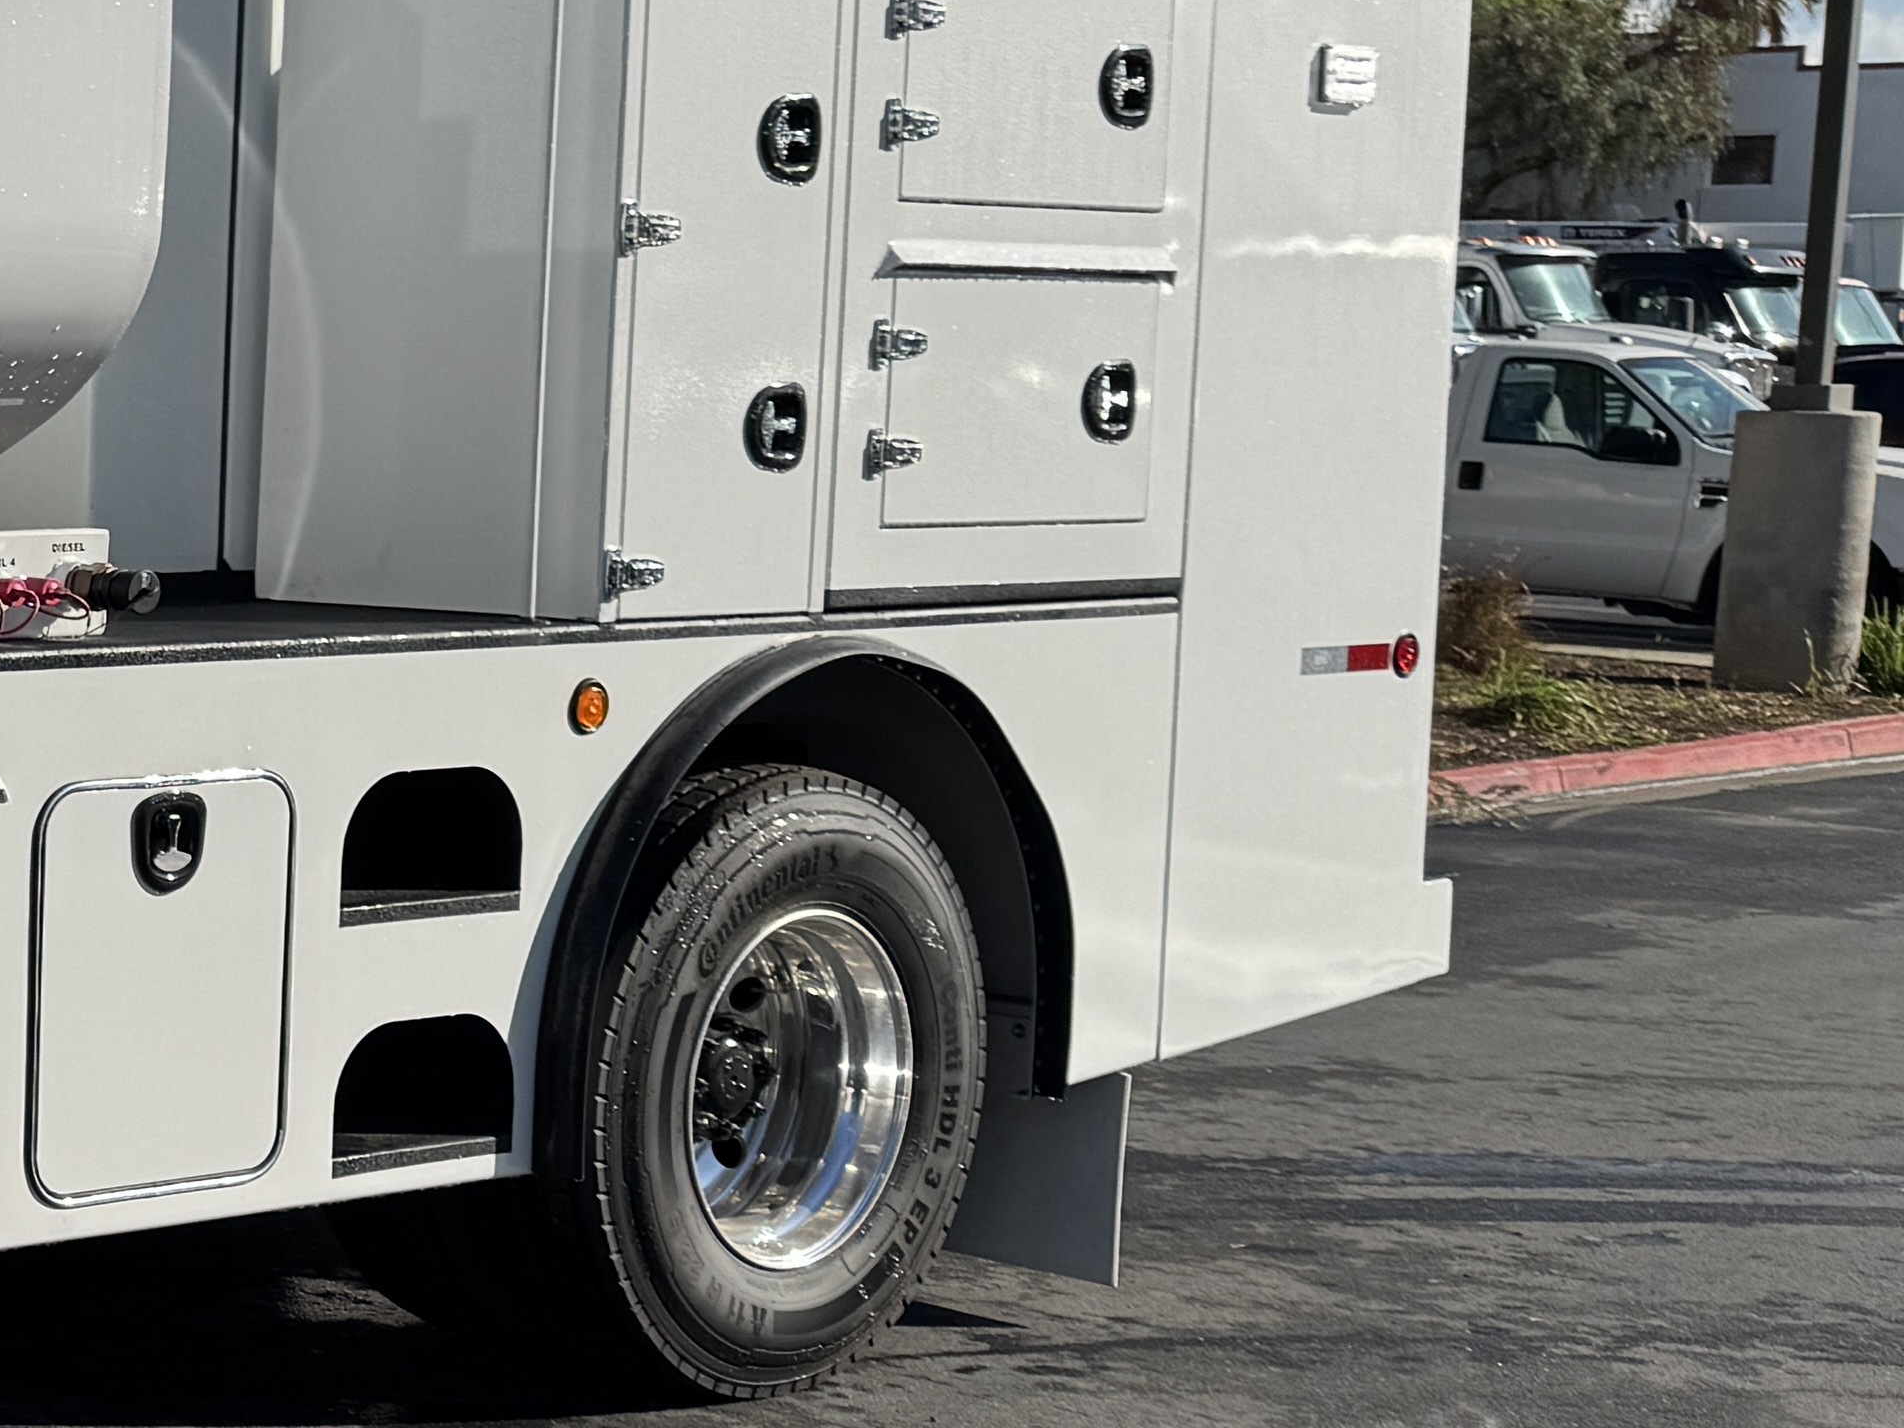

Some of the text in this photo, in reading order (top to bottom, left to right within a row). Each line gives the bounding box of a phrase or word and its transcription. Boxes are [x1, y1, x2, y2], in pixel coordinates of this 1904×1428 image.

[52, 542, 86, 553] DIESEL
[9, 558, 16, 567] 4
[698, 844, 820, 978] Continental
[932, 1084, 961, 1155] HDL
[924, 1166, 941, 1190] 3
